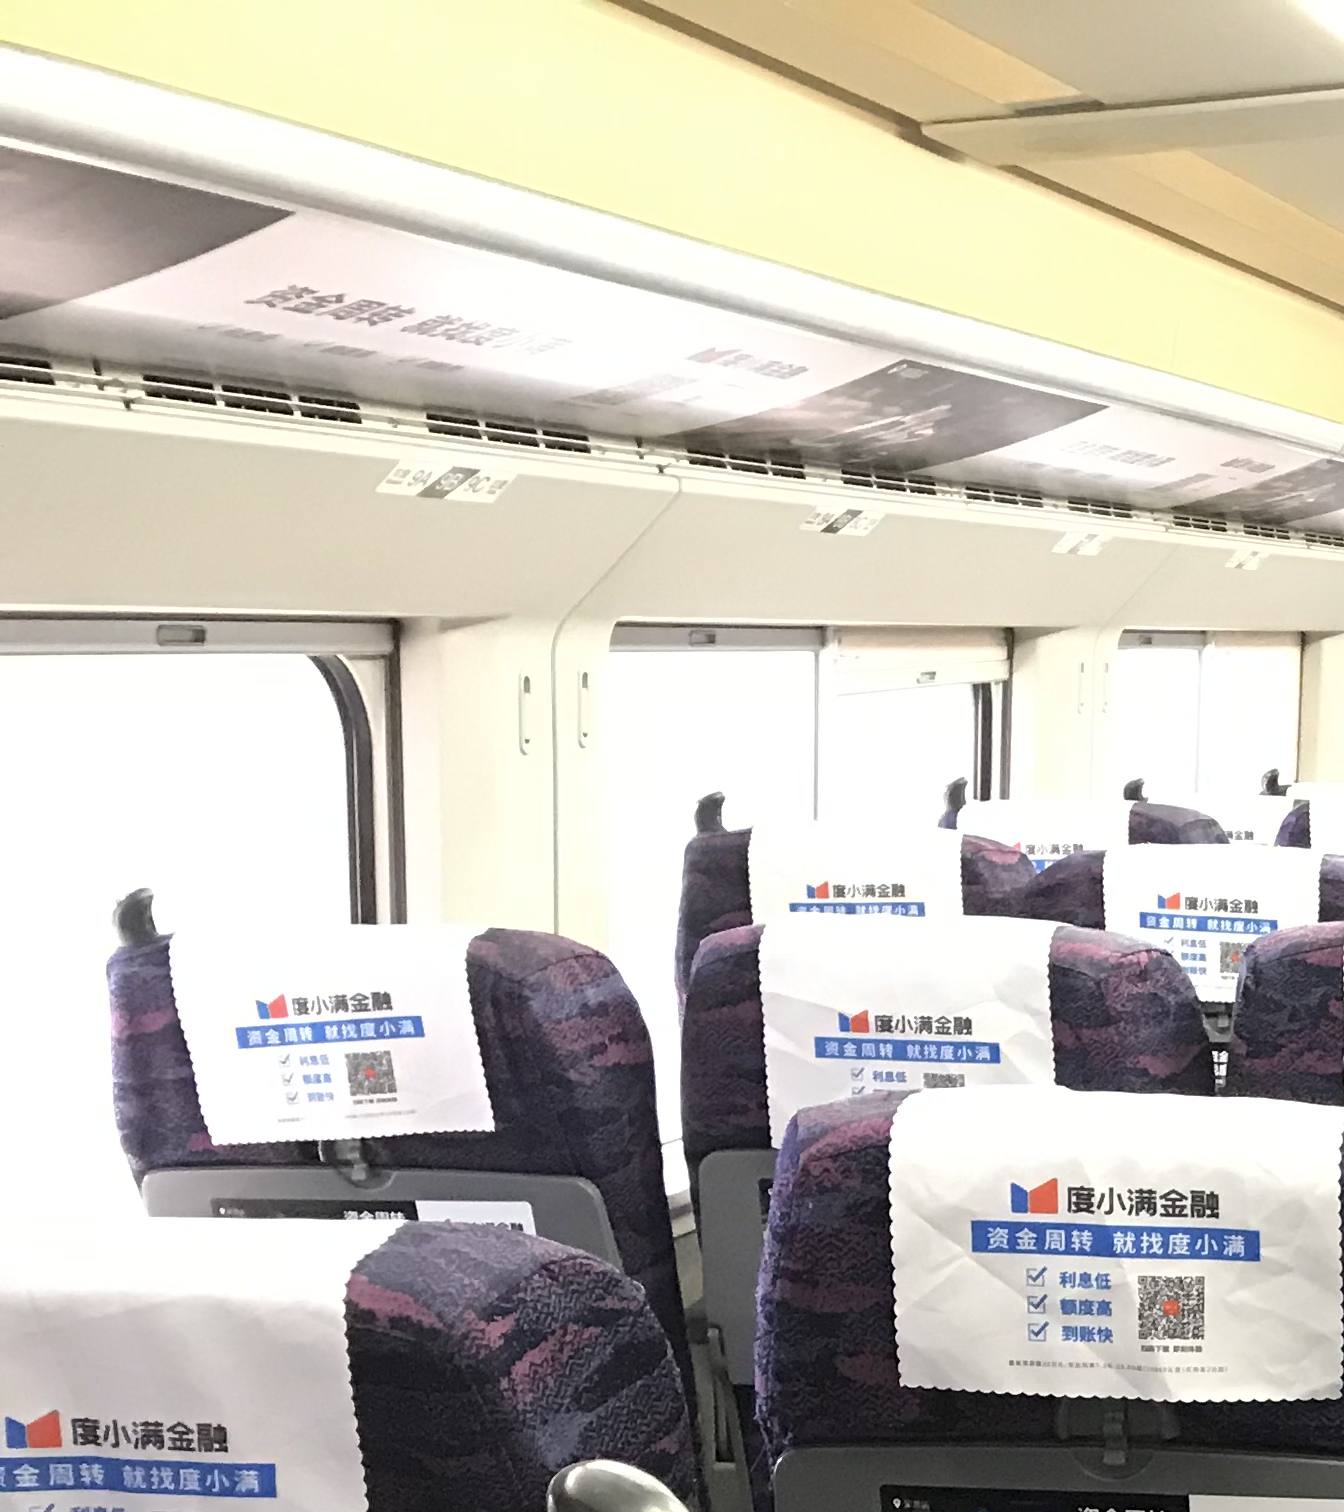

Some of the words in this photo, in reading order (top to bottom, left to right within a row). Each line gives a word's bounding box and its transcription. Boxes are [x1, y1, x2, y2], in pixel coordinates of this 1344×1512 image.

[833, 884, 905, 899] 度小满金融
[1184, 896, 1259, 914] 度小满金融
[292, 992, 393, 1016] 度小满金融
[247, 1027, 313, 1046] 资金周转
[325, 1020, 414, 1040] 就找度小满
[875, 1015, 973, 1036] 度小满金融
[825, 1041, 893, 1059] 资金周转
[906, 1043, 990, 1061] 就找度小满
[1067, 1186, 1220, 1219] 度小满金融
[987, 1227, 1094, 1252] 资金周转
[1113, 1231, 1246, 1258] 就找度小满
[1059, 1271, 1112, 1290] 利息低
[1059, 1299, 1112, 1317] 额度高
[1061, 1326, 1114, 1343] 到账快
[71, 1417, 229, 1453] 度小满金融
[0, 1463, 105, 1487] 金周转
[121, 1466, 261, 1493] 就找度小满
